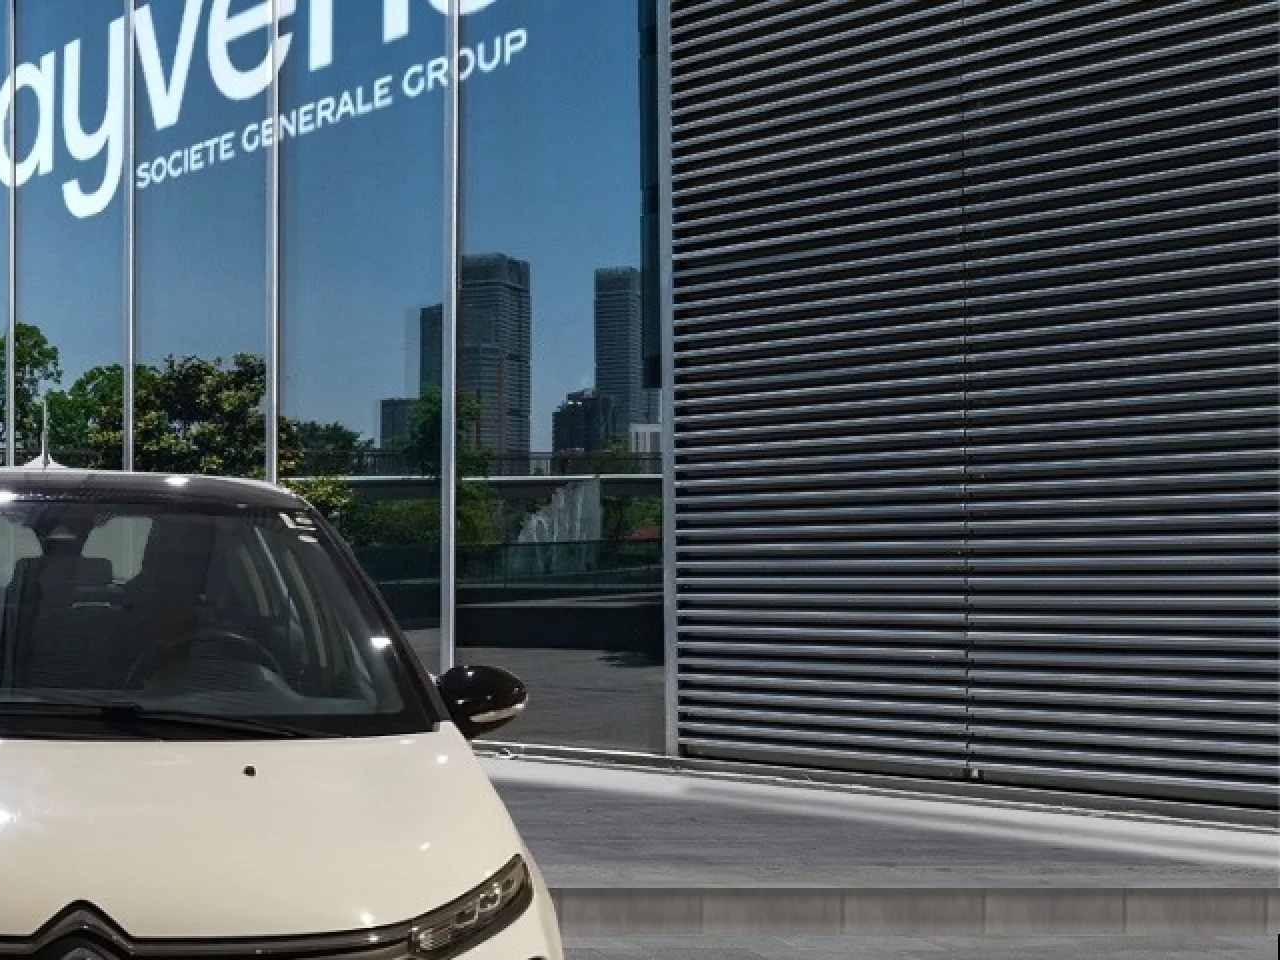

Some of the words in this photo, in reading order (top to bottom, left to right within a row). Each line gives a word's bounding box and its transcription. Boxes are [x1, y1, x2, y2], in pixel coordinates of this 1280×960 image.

[135, 131, 236, 189] SOCIETE
[241, 76, 394, 154] GENERALE
[399, 28, 529, 97] GROUP
